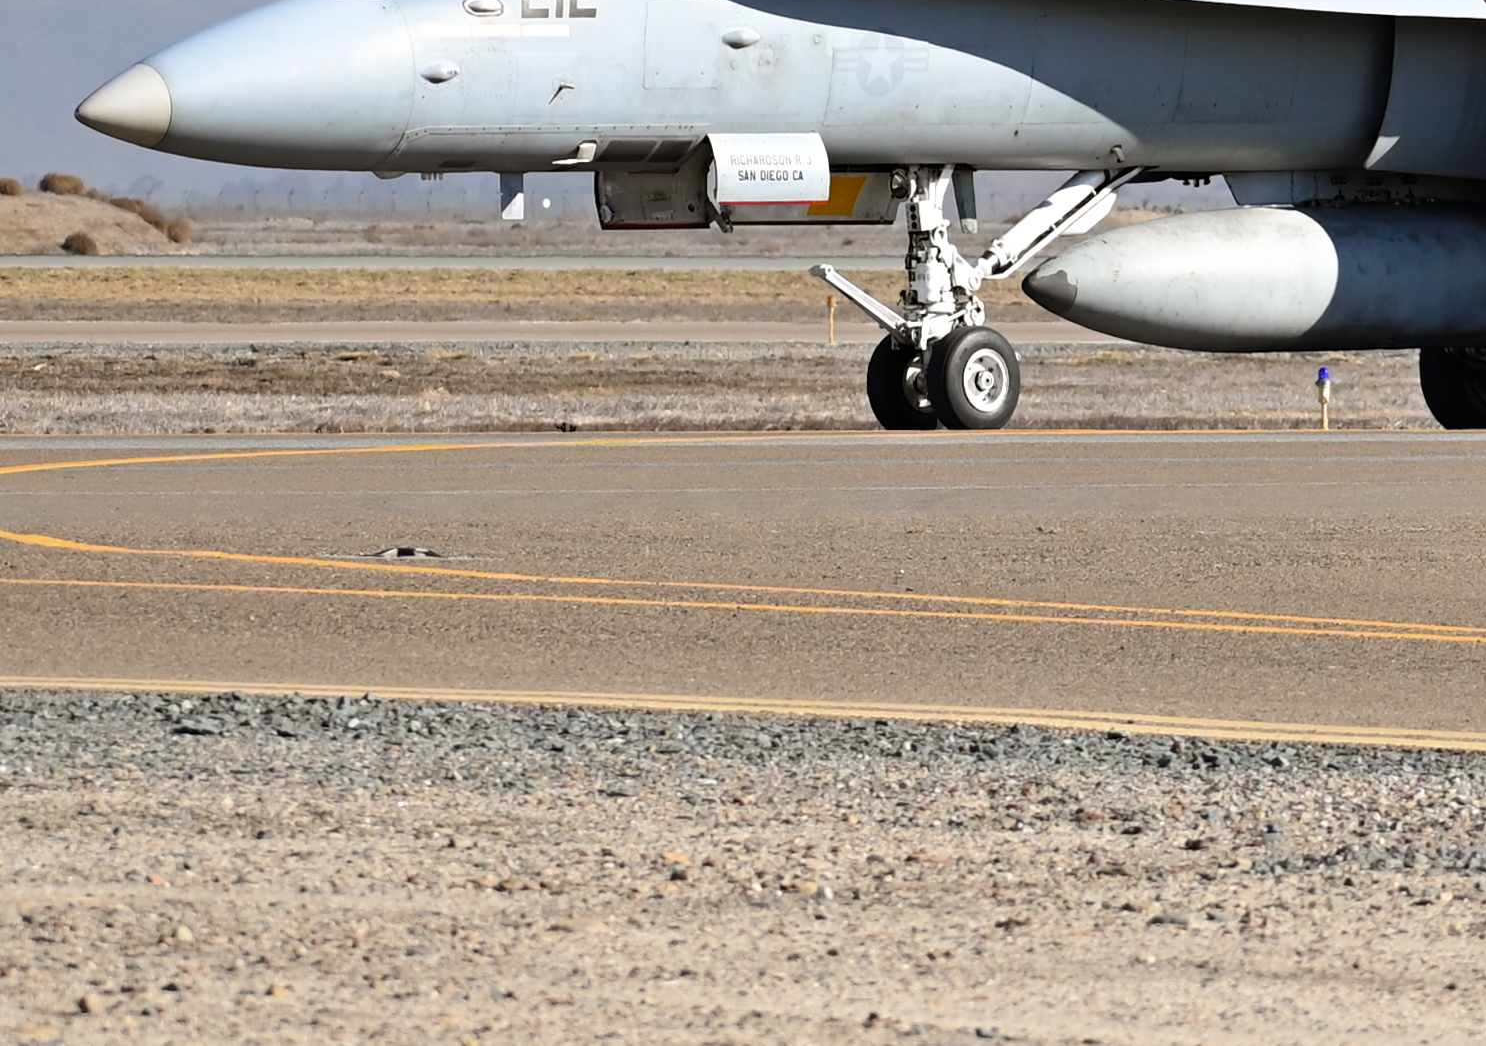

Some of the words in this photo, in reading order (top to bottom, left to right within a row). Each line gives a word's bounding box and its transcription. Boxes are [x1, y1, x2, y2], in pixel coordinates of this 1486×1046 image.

[730, 154, 792, 166] RICHARDSON
[795, 154, 802, 166] R
[738, 170, 756, 181] SAN
[760, 170, 789, 181] DIEGO
[792, 170, 804, 181] CA
